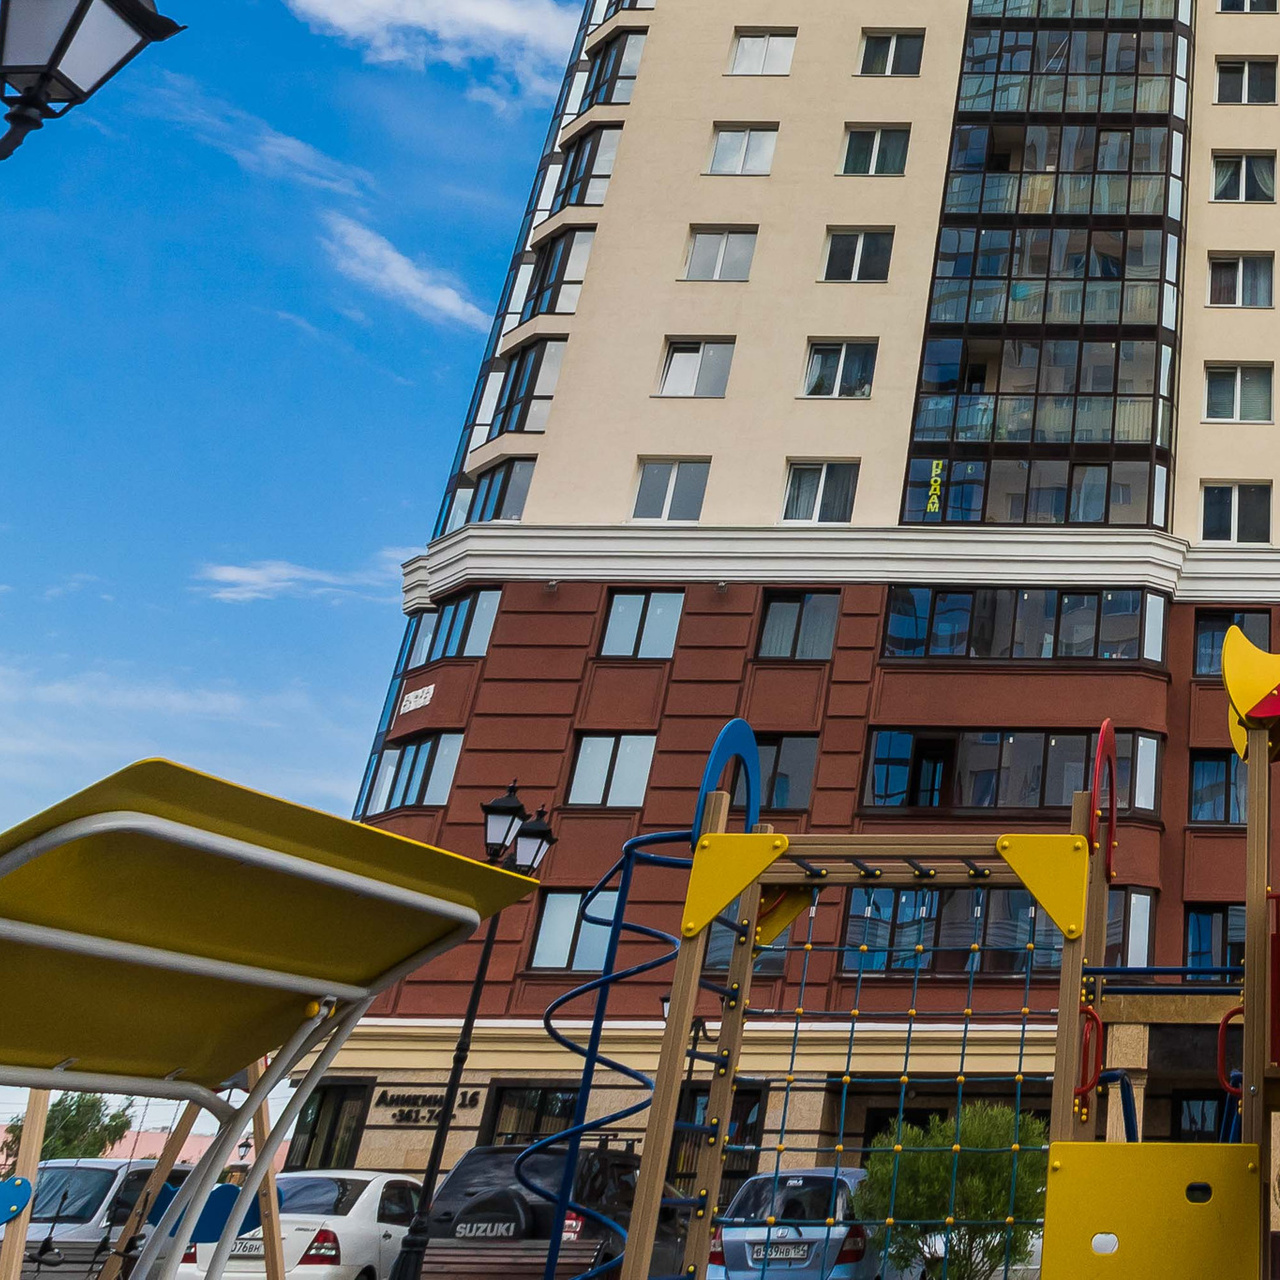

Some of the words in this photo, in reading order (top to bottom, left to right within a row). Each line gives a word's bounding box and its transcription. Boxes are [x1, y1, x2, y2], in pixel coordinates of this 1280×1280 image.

[927, 460, 943, 512] ПРОДАМ
[375, 1090, 449, 1108] Аникин
[458, 1090, 480, 1108] 16
[455, 1222, 517, 1238] SUZUKI
